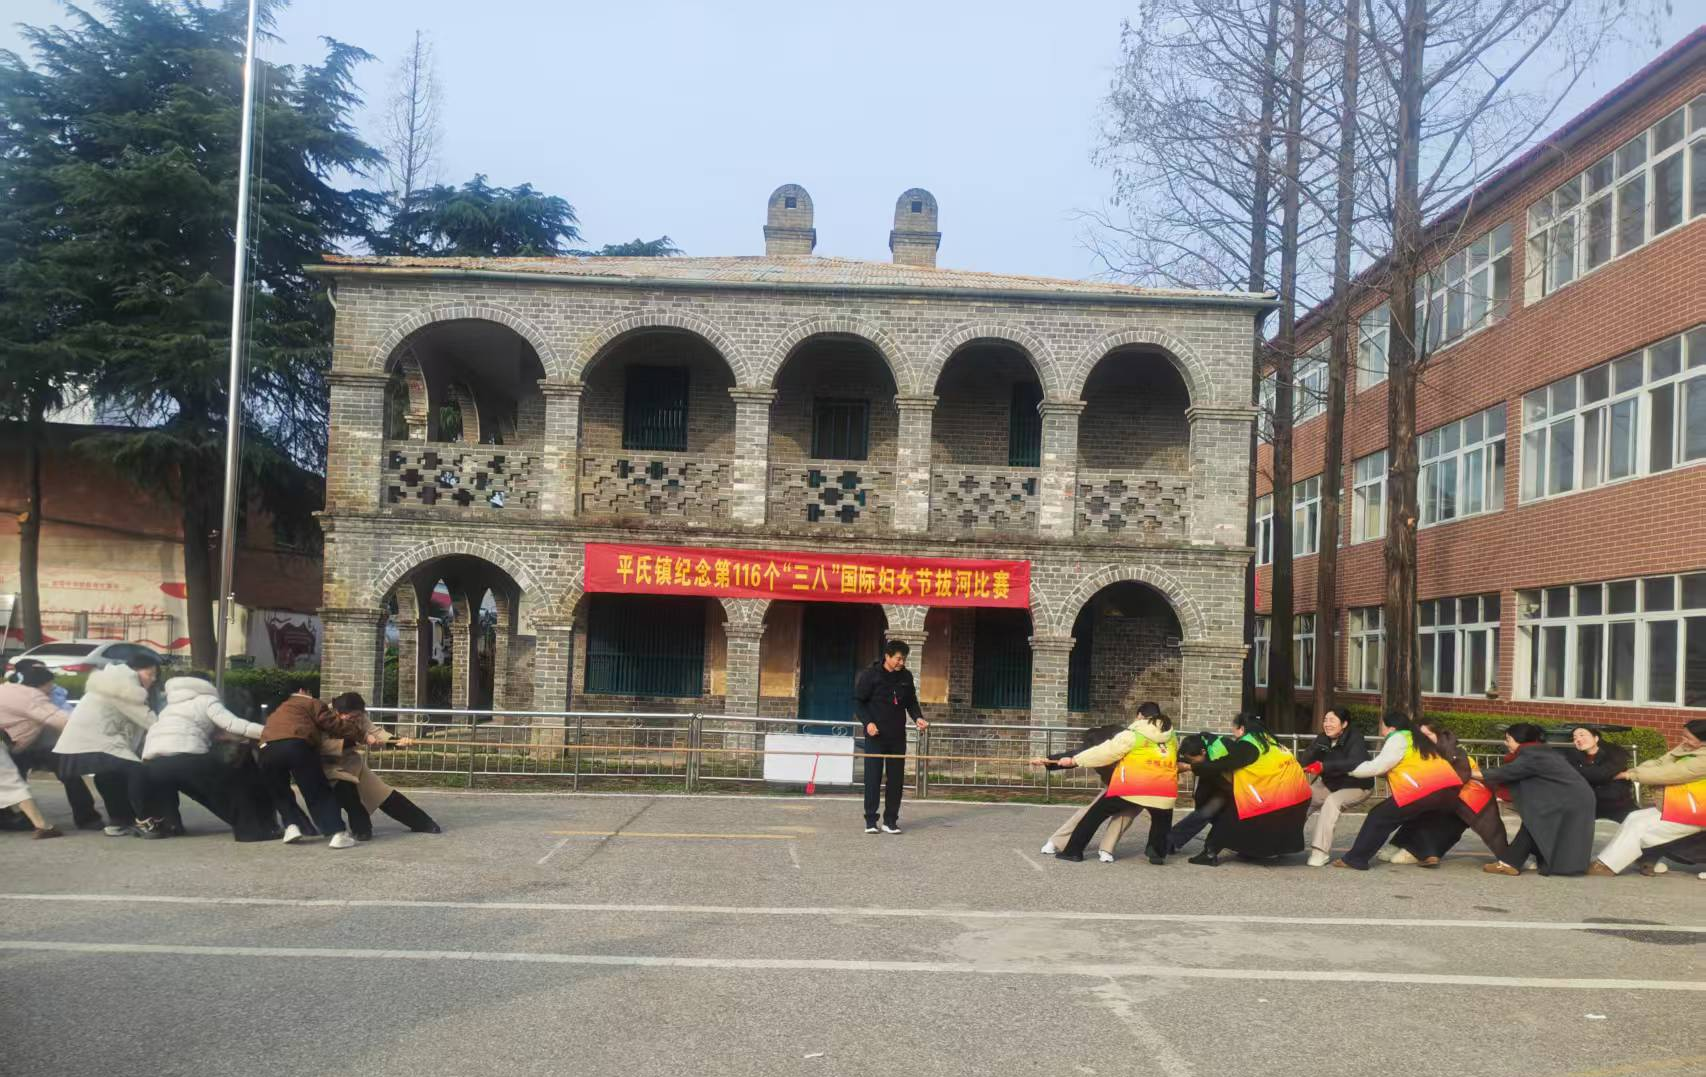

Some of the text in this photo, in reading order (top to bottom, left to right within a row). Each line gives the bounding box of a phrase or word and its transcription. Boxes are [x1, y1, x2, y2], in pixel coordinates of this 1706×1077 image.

[617, 554, 1010, 599] 平氏镇纪念第116个“三八”国际妇女节拔河比赛
